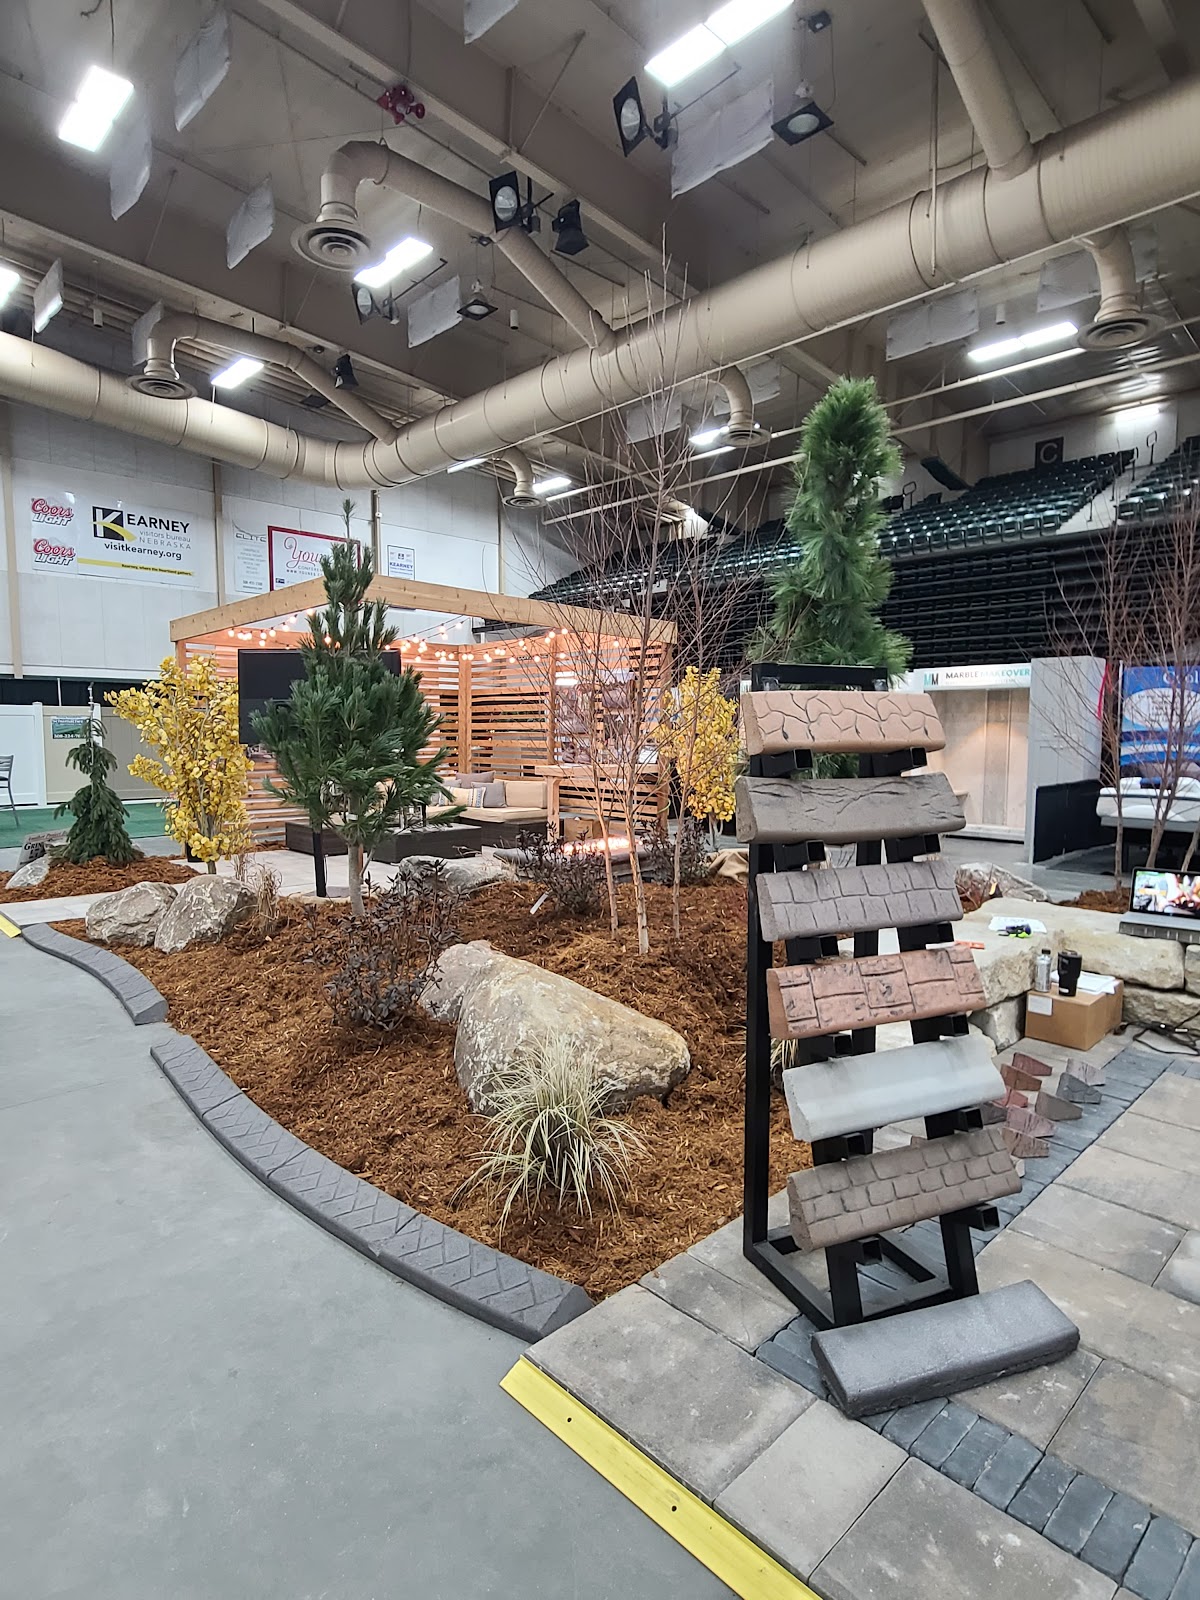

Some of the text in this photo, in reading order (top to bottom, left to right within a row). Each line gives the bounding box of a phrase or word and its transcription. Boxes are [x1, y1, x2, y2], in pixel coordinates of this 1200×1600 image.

[1040, 442, 1058, 464] C
[32, 498, 74, 518] Coors
[32, 513, 73, 527] LIGHT
[139, 530, 191, 542] visitors bureau
[139, 537, 191, 549] NEBRASKA
[33, 538, 76, 558] Coors
[104, 542, 182, 560] visitkearney.org
[34, 553, 74, 566] LIGHT
[945, 671, 978, 679] MARBLE
